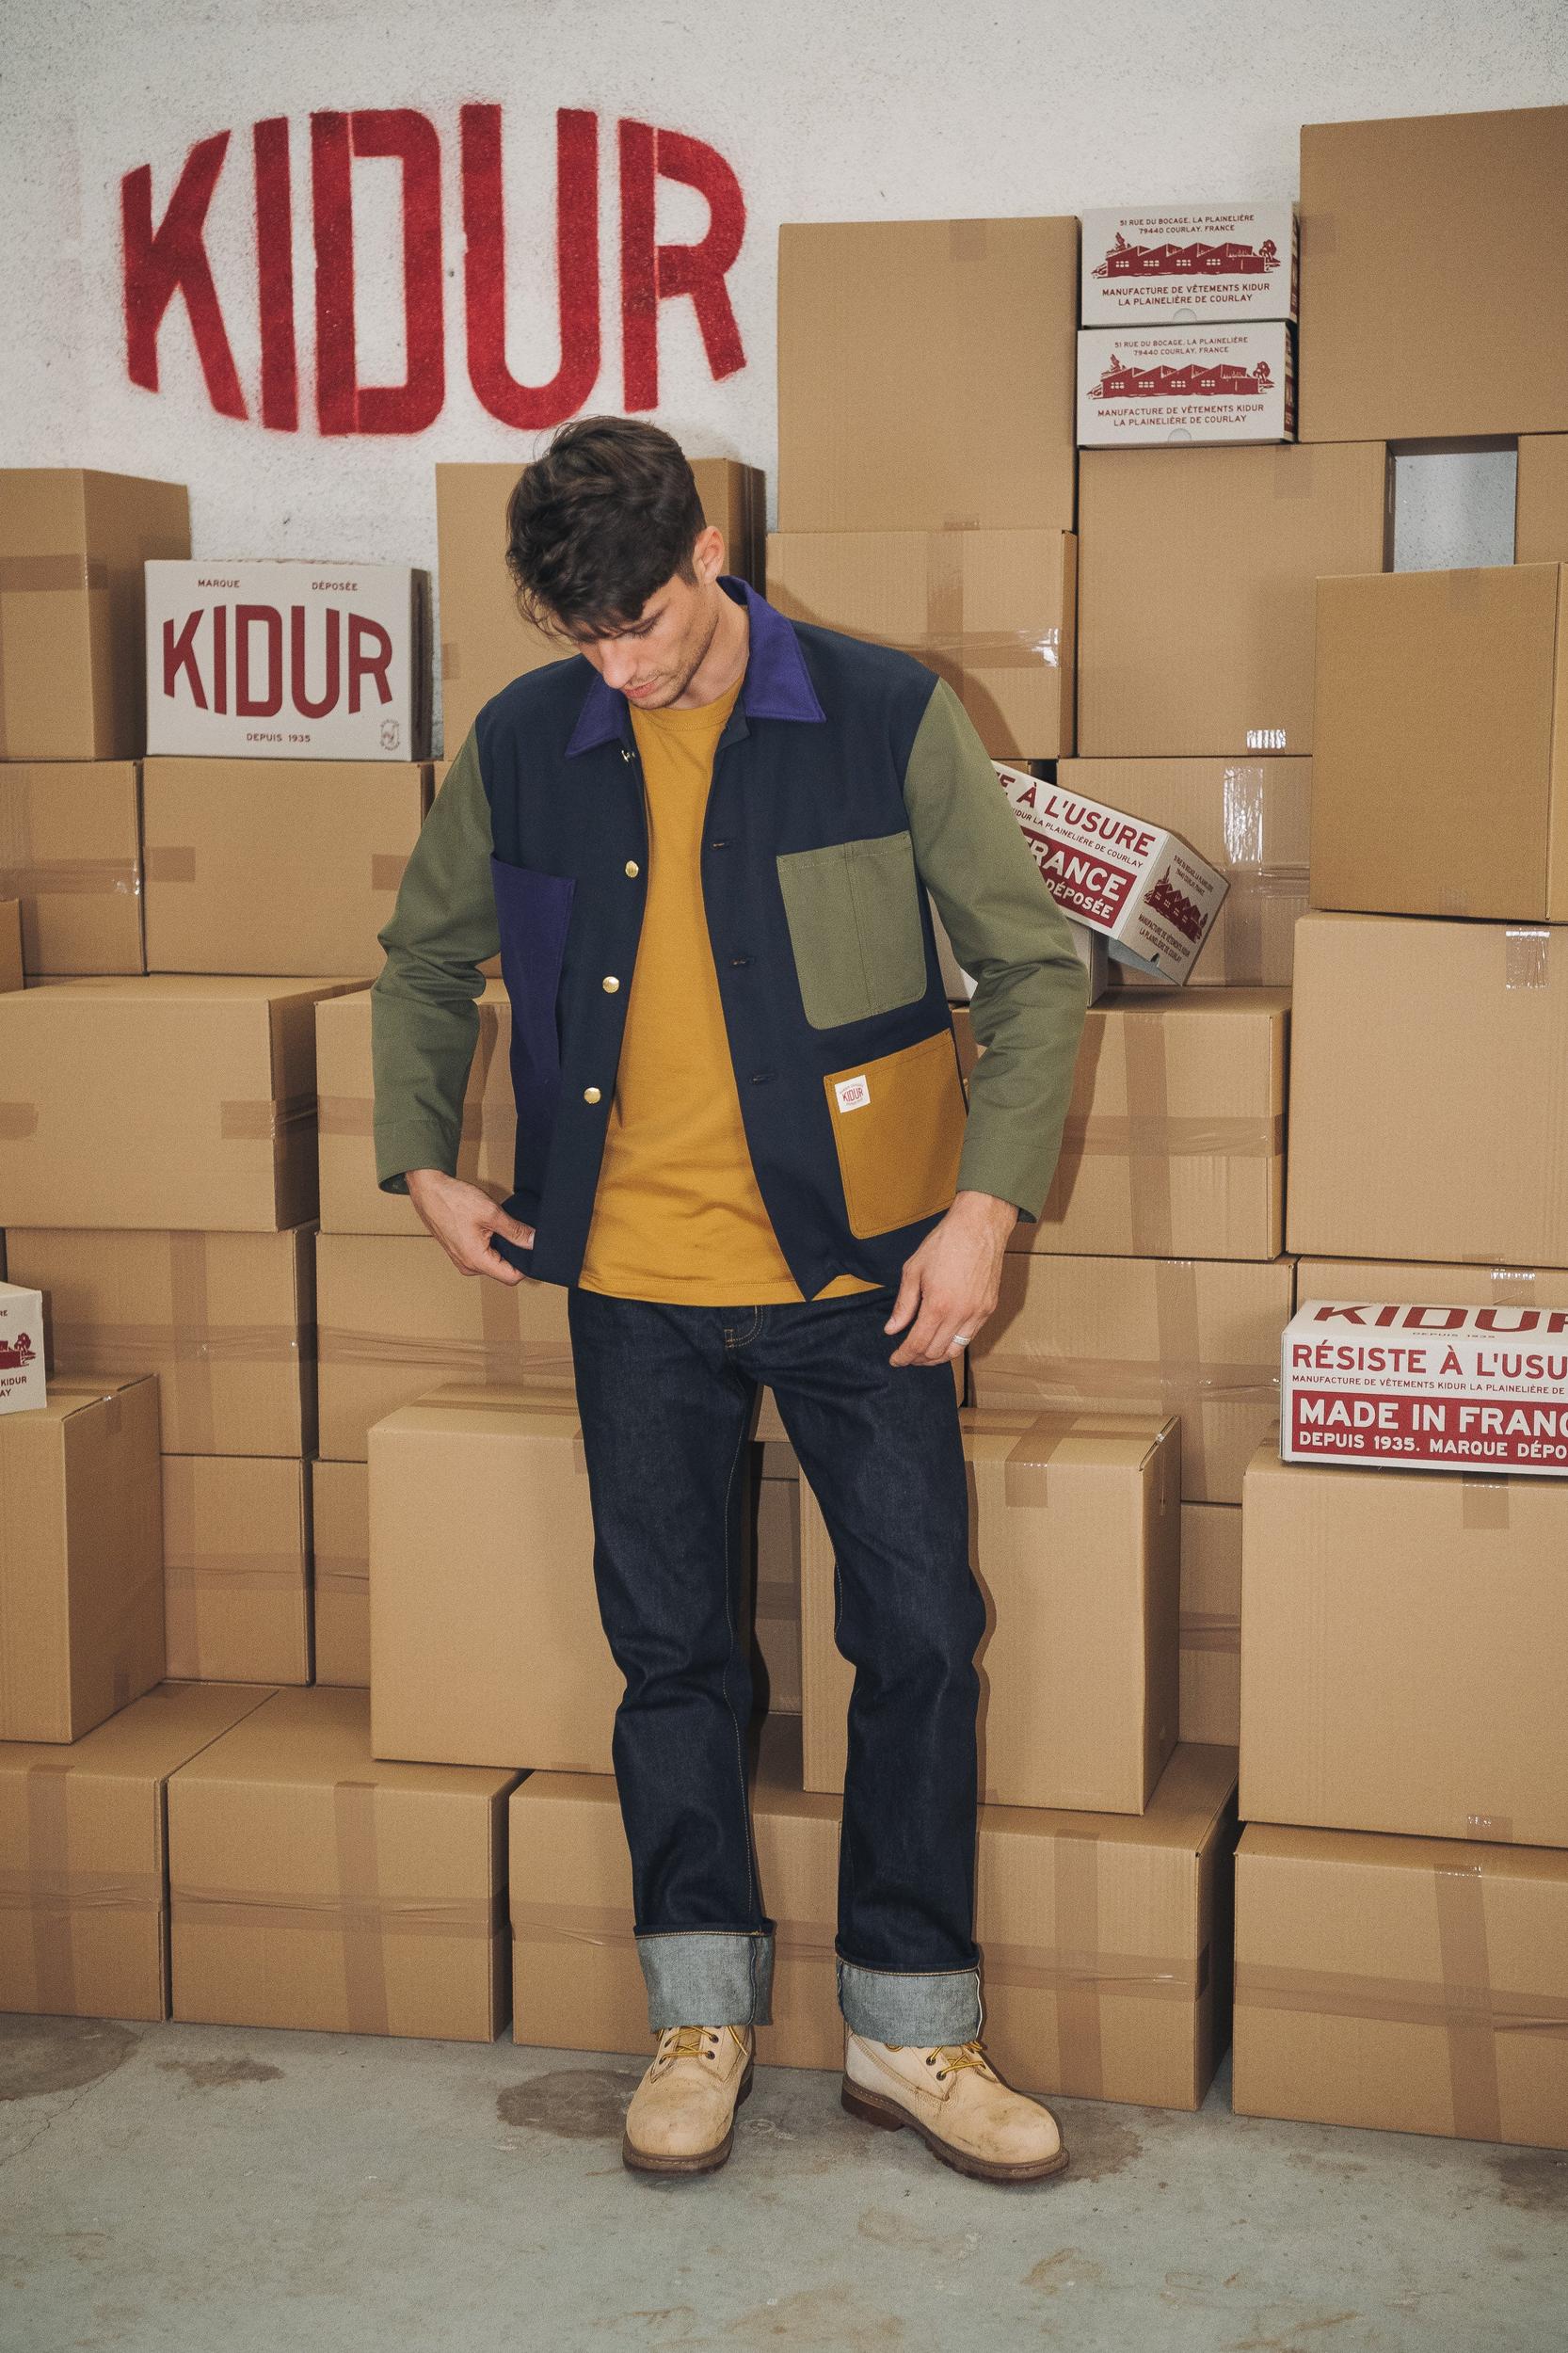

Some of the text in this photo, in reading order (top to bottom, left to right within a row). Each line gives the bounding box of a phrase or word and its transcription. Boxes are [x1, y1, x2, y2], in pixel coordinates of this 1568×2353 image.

[1205, 214, 1255, 223] PLAINELIÈRE
[120, 104, 746, 436] KIDUR
[1102, 286, 1168, 296] MANUFACTURE
[1172, 285, 1183, 294] DE
[1186, 283, 1240, 294] VÊTEMENTS
[1134, 295, 1192, 305] PLAINELIÈRE
[1210, 294, 1253, 303] COURLAY
[1097, 407, 1163, 417] MANUFACTURE
[1181, 404, 1234, 414] VÊTEMENTS
[1237, 404, 1264, 412] KIDUR
[1129, 415, 1187, 425] PLAINELIÈRE
[1205, 414, 1247, 423] COURLAY
[198, 580, 359, 591] MARQUE DÉPOSÉE
[163, 604, 392, 719] KIDUR
[247, 732, 311, 743] DEPUIS 1935
[1016, 782, 1037, 808] À
[1044, 795, 1156, 857] L'USURE
[1013, 808, 1144, 869] IDUR LA PLAINELIÈRE DE COURLAY
[1046, 878, 1113, 920] DÉPOSÉE
[842, 1088, 863, 1101] KIDUR
[1292, 1339, 1426, 1373] RÉSISTE
[1439, 1345, 1463, 1375] À
[1, 1376, 26, 1386] KIDUR
[1292, 1375, 1361, 1385] MANUFACTURE
[1380, 1377, 1434, 1389] VÊTEMENTS
[1437, 1381, 1466, 1390] KIDUR
[1470, 1383, 1482, 1391] LA
[1486, 1384, 1549, 1394] PLAINELIÈRE
[1300, 1398, 1400, 1430] MADE
[1412, 1403, 1446, 1432] IN
[1299, 1432, 1365, 1449] DEPUIS
[1374, 1435, 1420, 1451] 1935.
[1430, 1438, 1508, 1457] MARQUE
